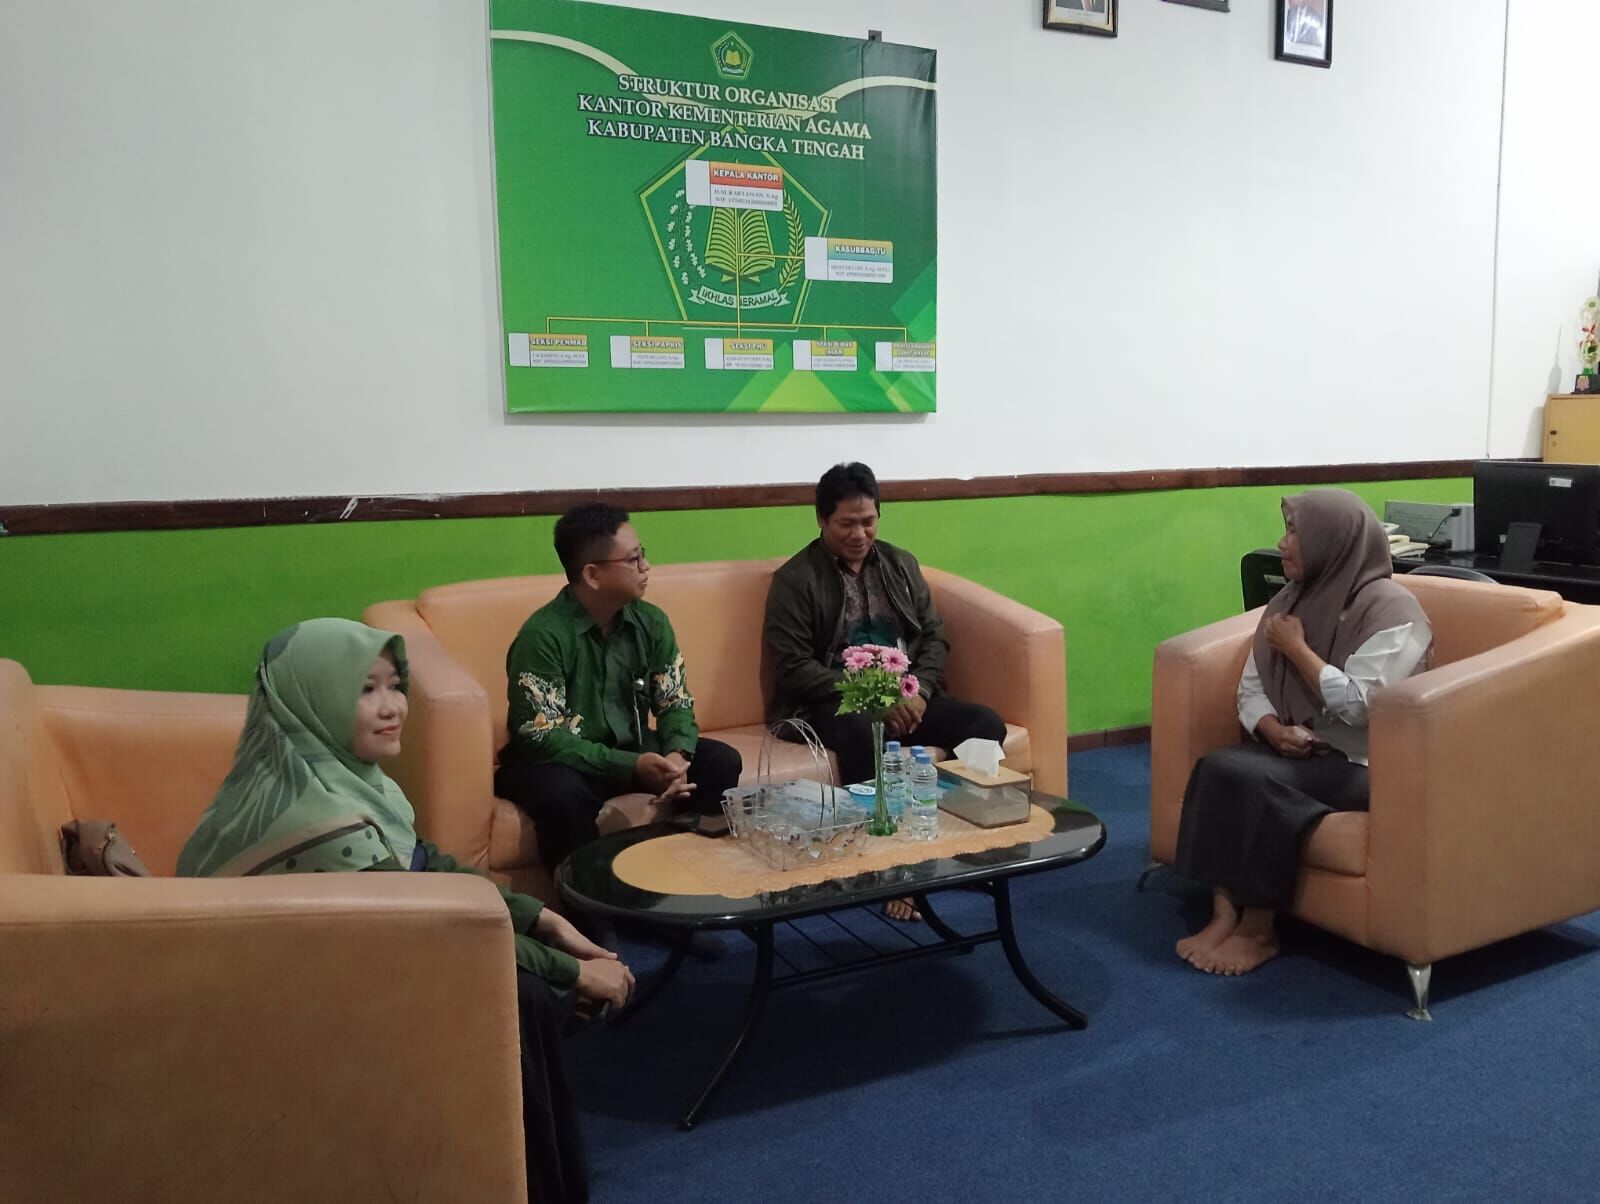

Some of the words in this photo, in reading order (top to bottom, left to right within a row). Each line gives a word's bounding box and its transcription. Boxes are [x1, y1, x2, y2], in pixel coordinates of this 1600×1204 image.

[618, 73, 722, 101] STRUKTUR
[725, 86, 838, 114] ORGANISASI
[577, 93, 664, 119] KANTOR
[668, 103, 802, 131] KEMENTERIAN
[804, 121, 872, 139] AGAMA
[587, 119, 706, 144] KABUPATEN
[710, 131, 789, 153] BANGKA
[791, 139, 865, 160] TENGAH
[713, 169, 745, 179] KEPALA
[746, 172, 779, 182] KANTOR
[702, 288, 735, 306] IKHLAS
